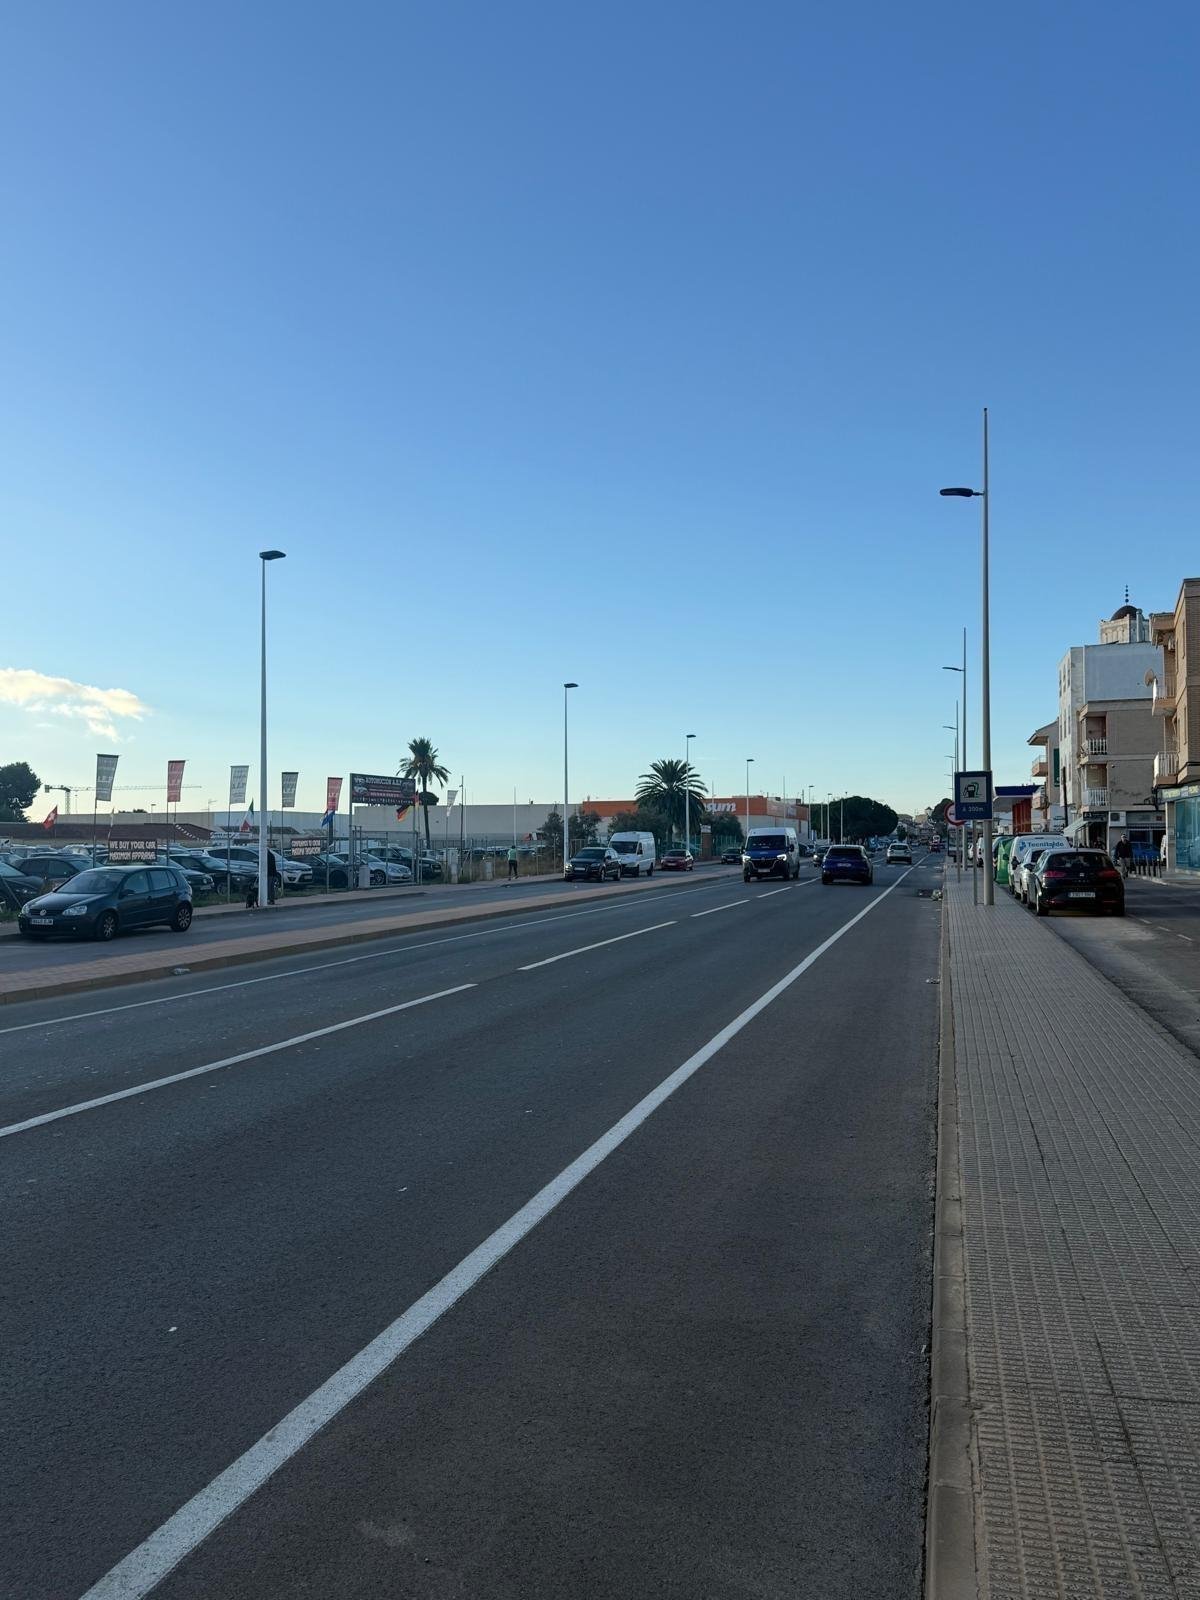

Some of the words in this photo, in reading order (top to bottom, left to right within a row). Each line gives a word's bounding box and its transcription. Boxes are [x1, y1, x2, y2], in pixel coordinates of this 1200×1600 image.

[109, 840, 118, 849] WE
[119, 840, 129, 850] BUY
[130, 840, 145, 849] YOUR
[145, 840, 156, 849] CAR
